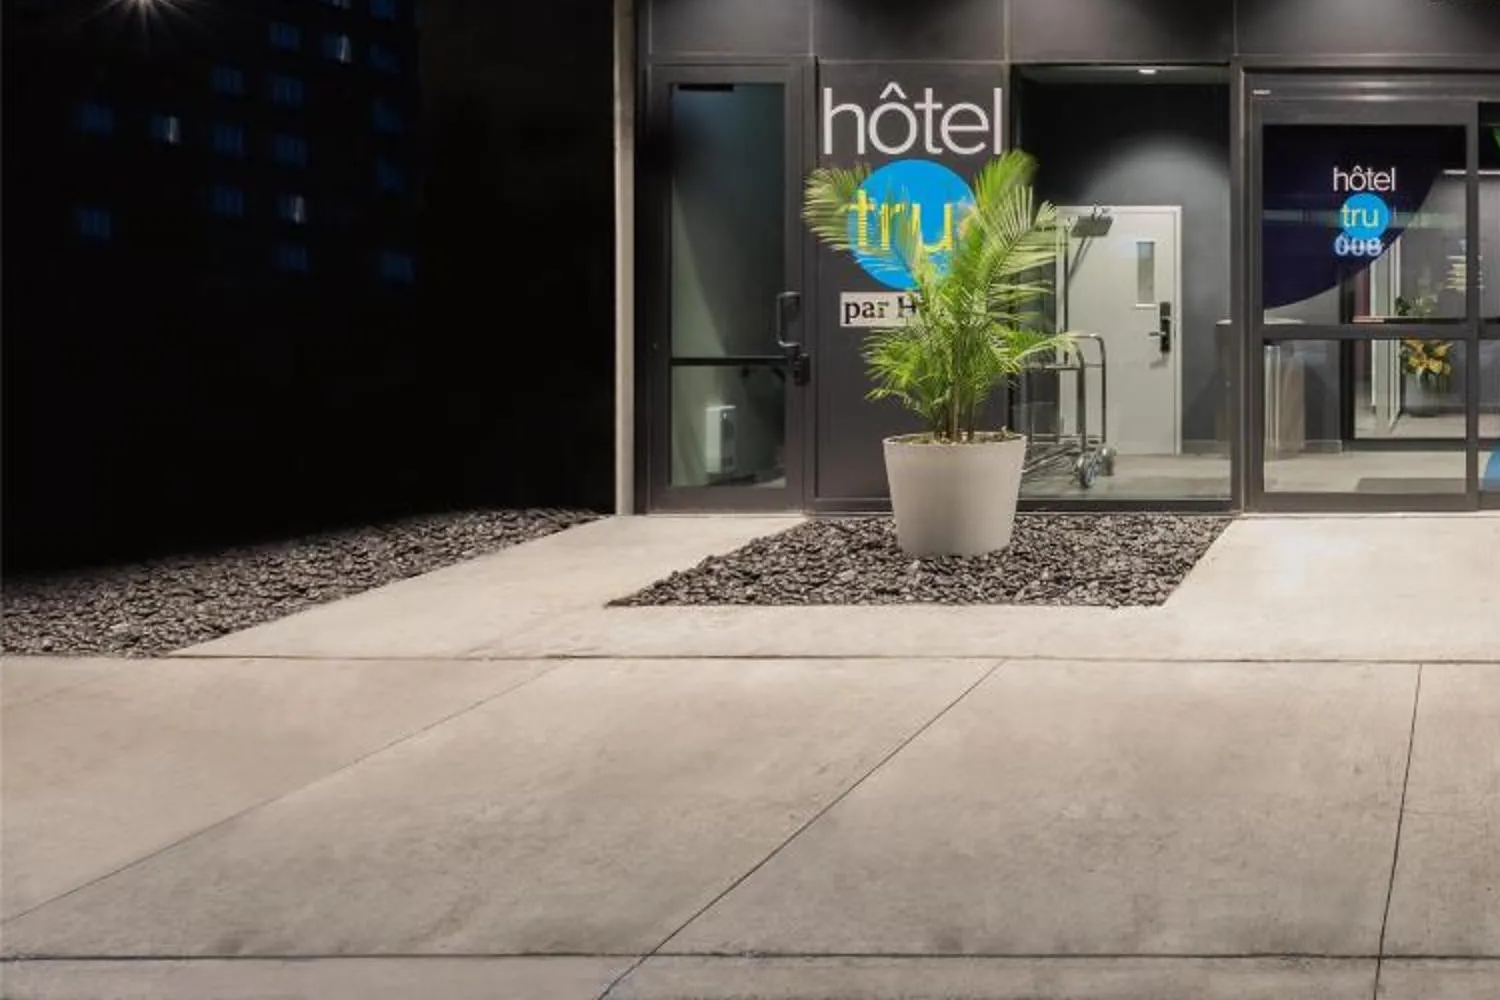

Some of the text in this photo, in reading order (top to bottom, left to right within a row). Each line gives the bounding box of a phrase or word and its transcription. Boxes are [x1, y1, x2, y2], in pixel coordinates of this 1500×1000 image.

[823, 82, 1003, 155] hôtel
[1333, 165, 1396, 191] hôtel
[849, 189, 953, 251] tru
[1341, 204, 1379, 227] tru
[844, 301, 890, 324] par
